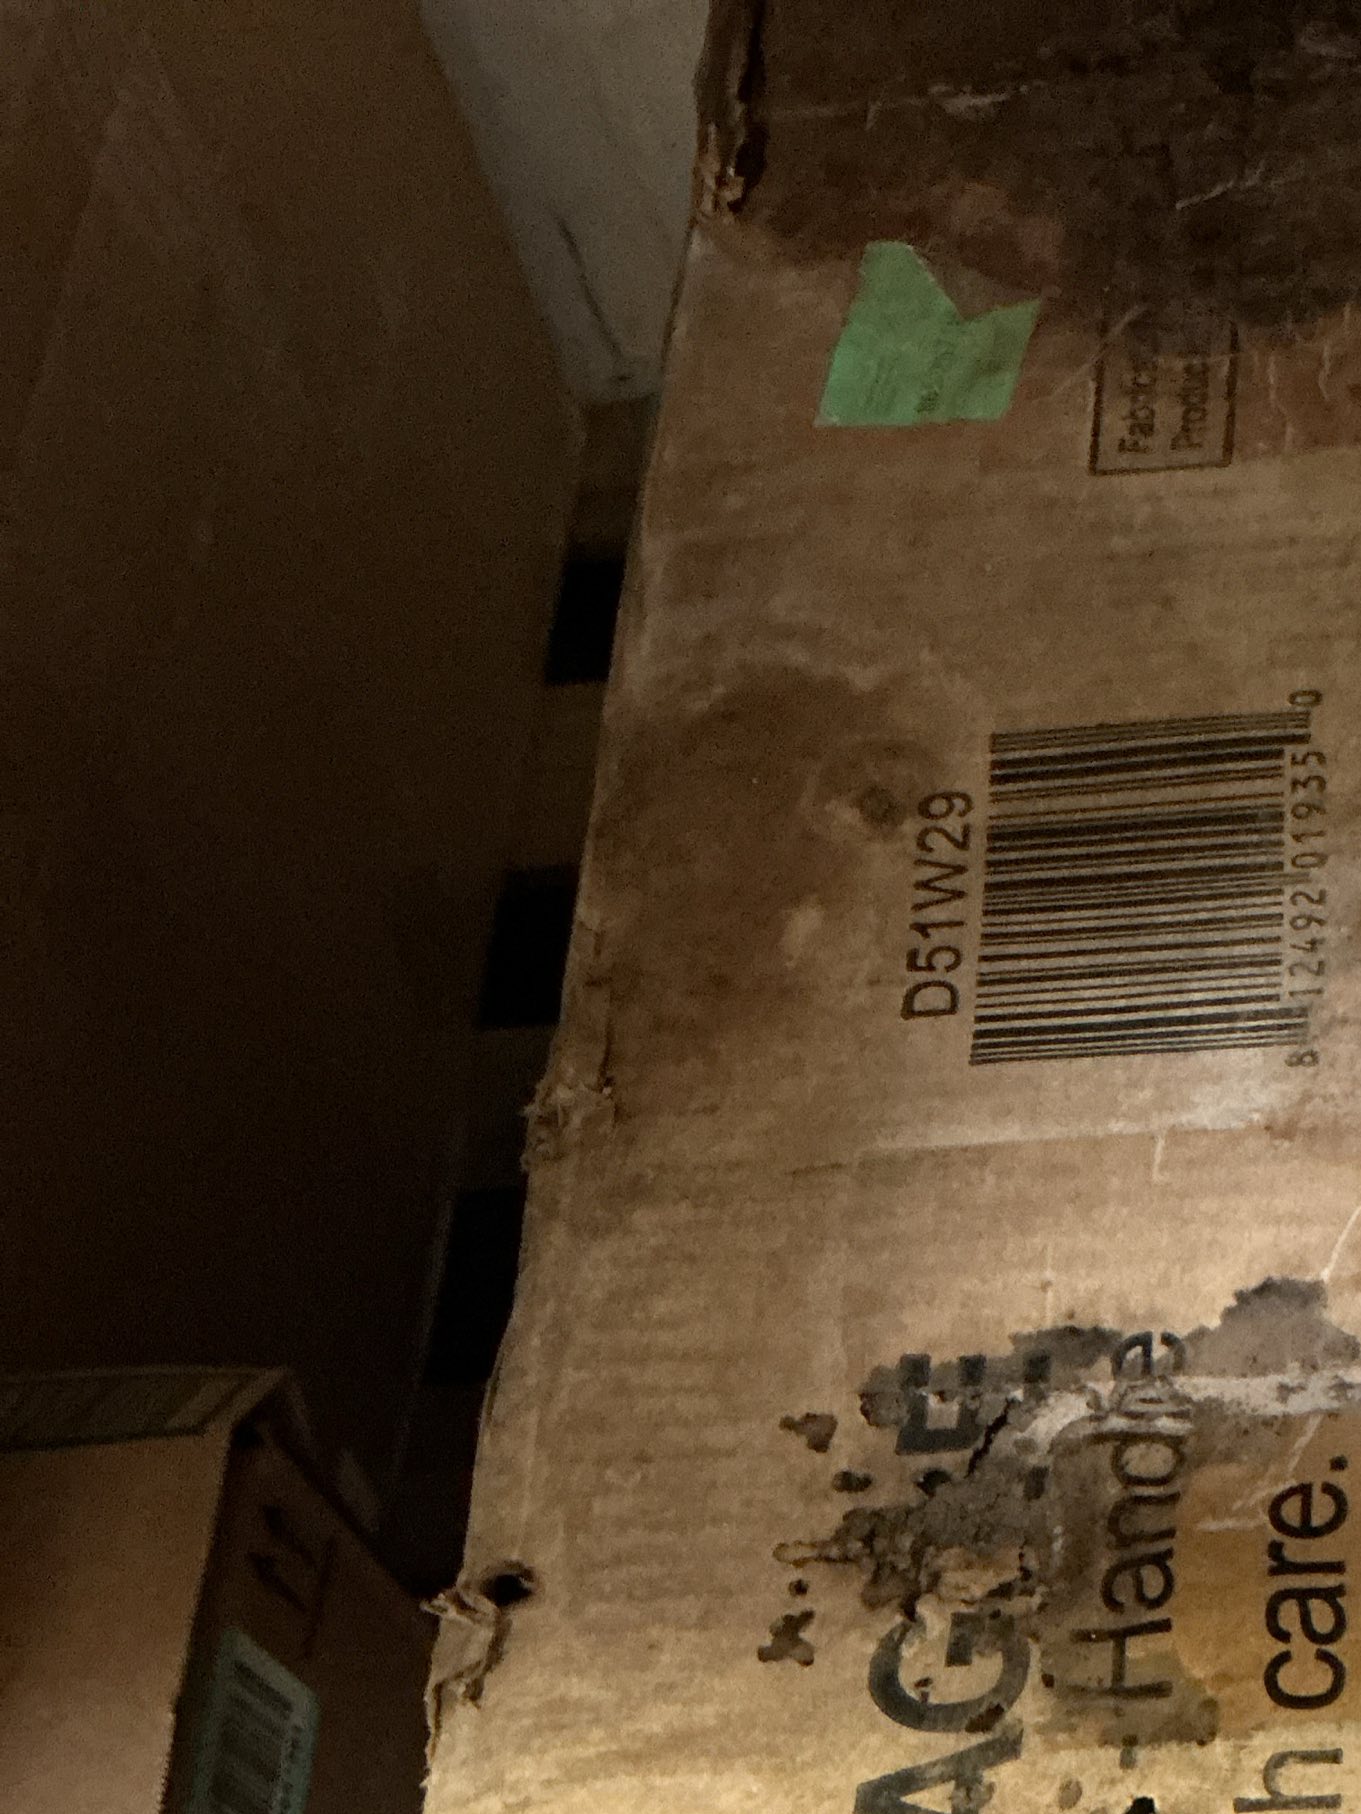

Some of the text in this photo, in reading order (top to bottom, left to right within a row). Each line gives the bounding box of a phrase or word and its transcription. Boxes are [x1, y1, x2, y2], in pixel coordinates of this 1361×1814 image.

[1287, 689, 1324, 707] 0
[1290, 750, 1328, 870] 01935
[901, 790, 974, 1021] D51W29
[1288, 888, 1327, 998] 12492
[1263, 1454, 1350, 1711] care.
